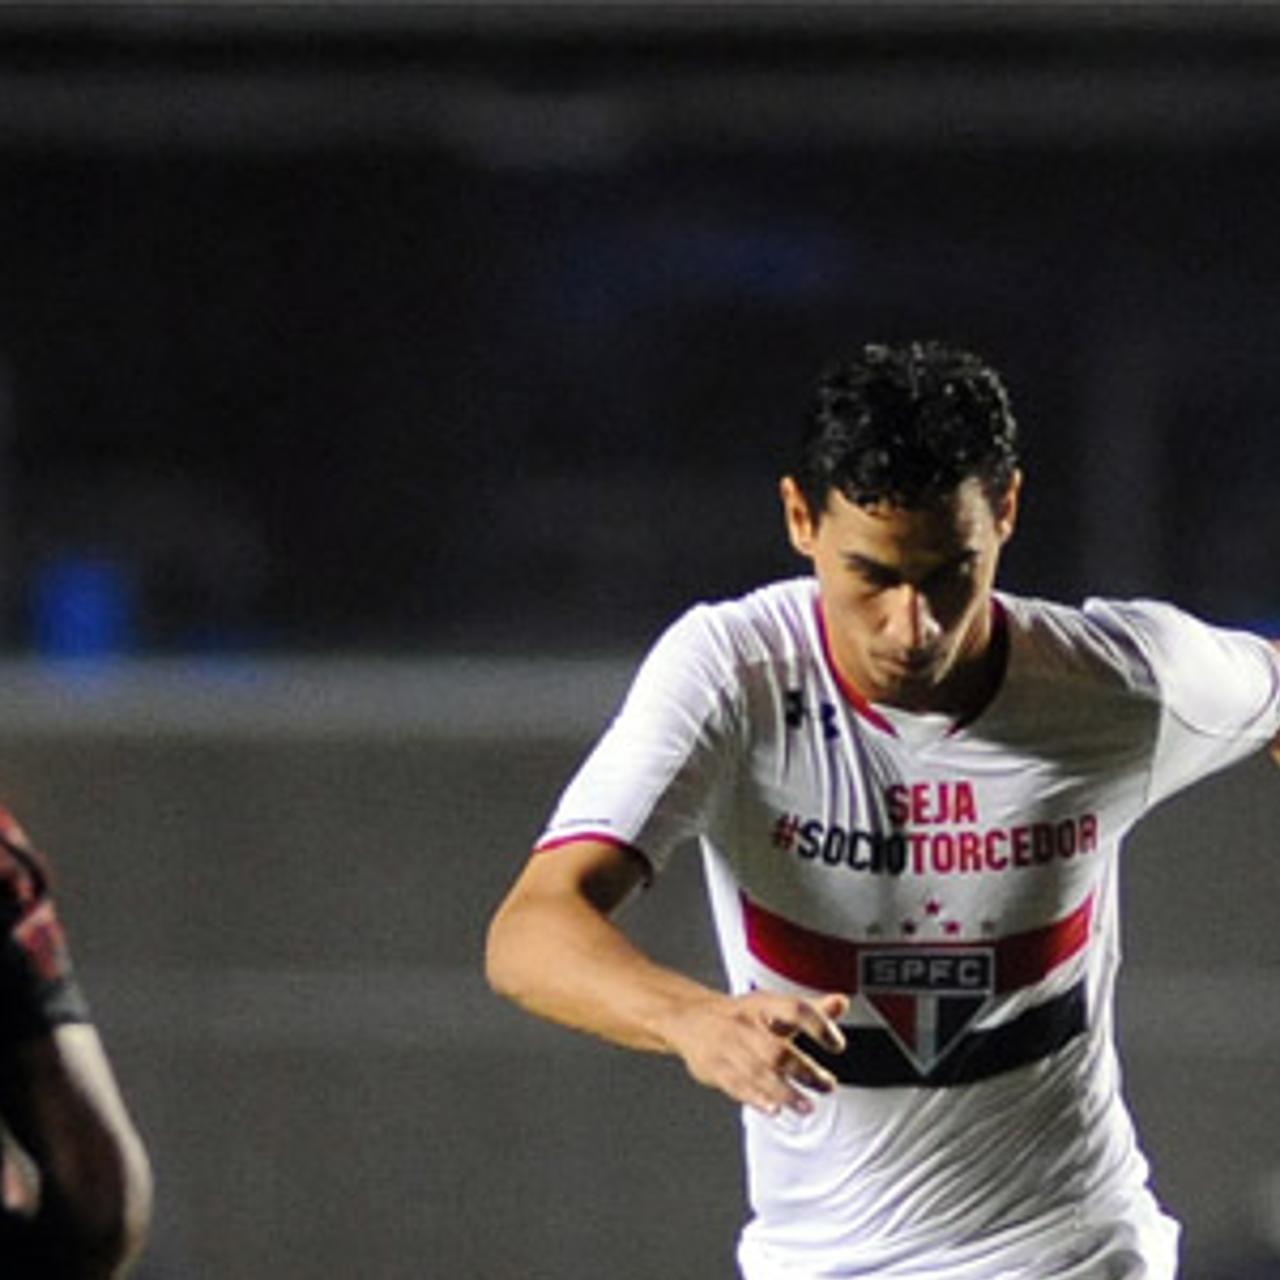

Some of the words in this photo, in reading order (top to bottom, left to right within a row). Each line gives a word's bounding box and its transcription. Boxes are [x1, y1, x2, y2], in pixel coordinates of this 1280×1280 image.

[887, 780, 978, 827] SEJA
[773, 813, 1099, 876] #SOCIOTORCEDOR
[872, 958, 984, 988] SPFC
